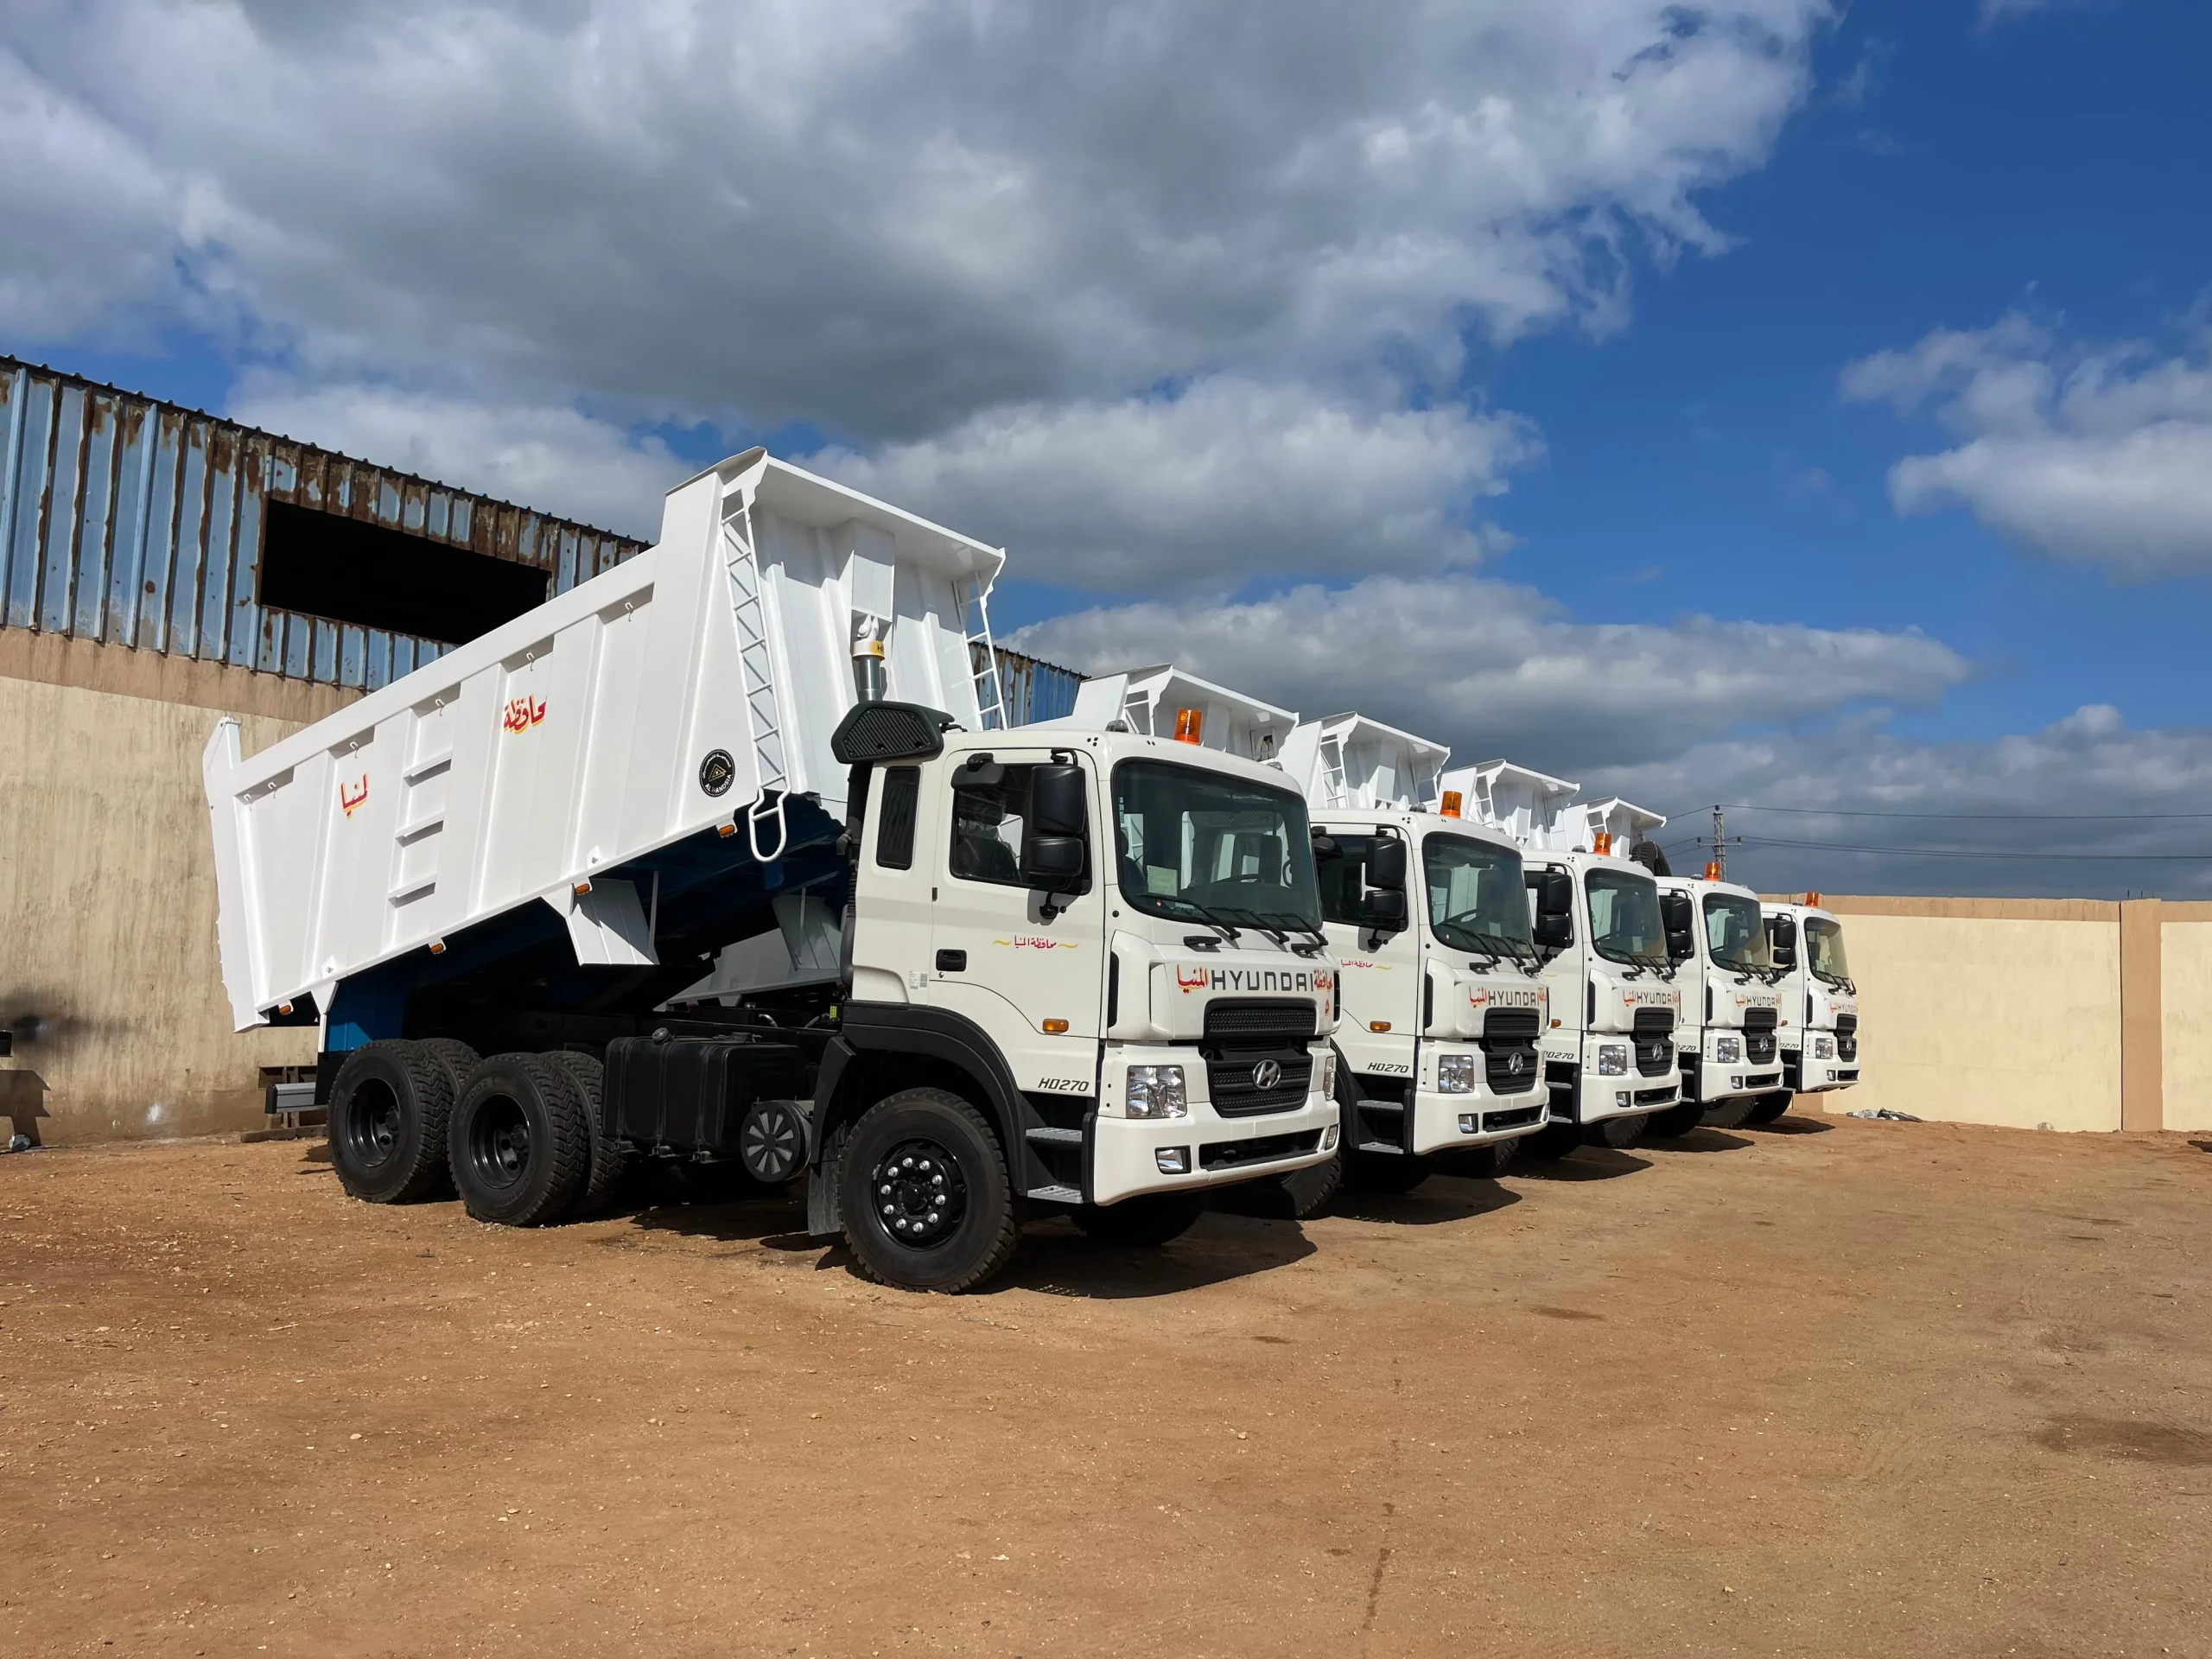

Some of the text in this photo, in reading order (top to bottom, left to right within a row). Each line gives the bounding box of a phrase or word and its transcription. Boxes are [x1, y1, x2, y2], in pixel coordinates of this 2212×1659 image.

[340, 694, 547, 820] حافظة لمنيا
[1014, 935, 1057, 949] محافظة المنيا
[1177, 963, 1208, 995] المنيا
[1211, 969, 1314, 992] HYUNDAI
[1488, 990, 1540, 1007] HYUNDAI
[1367, 1062, 1409, 1073] HD270
[1038, 1077, 1090, 1092] HD270
